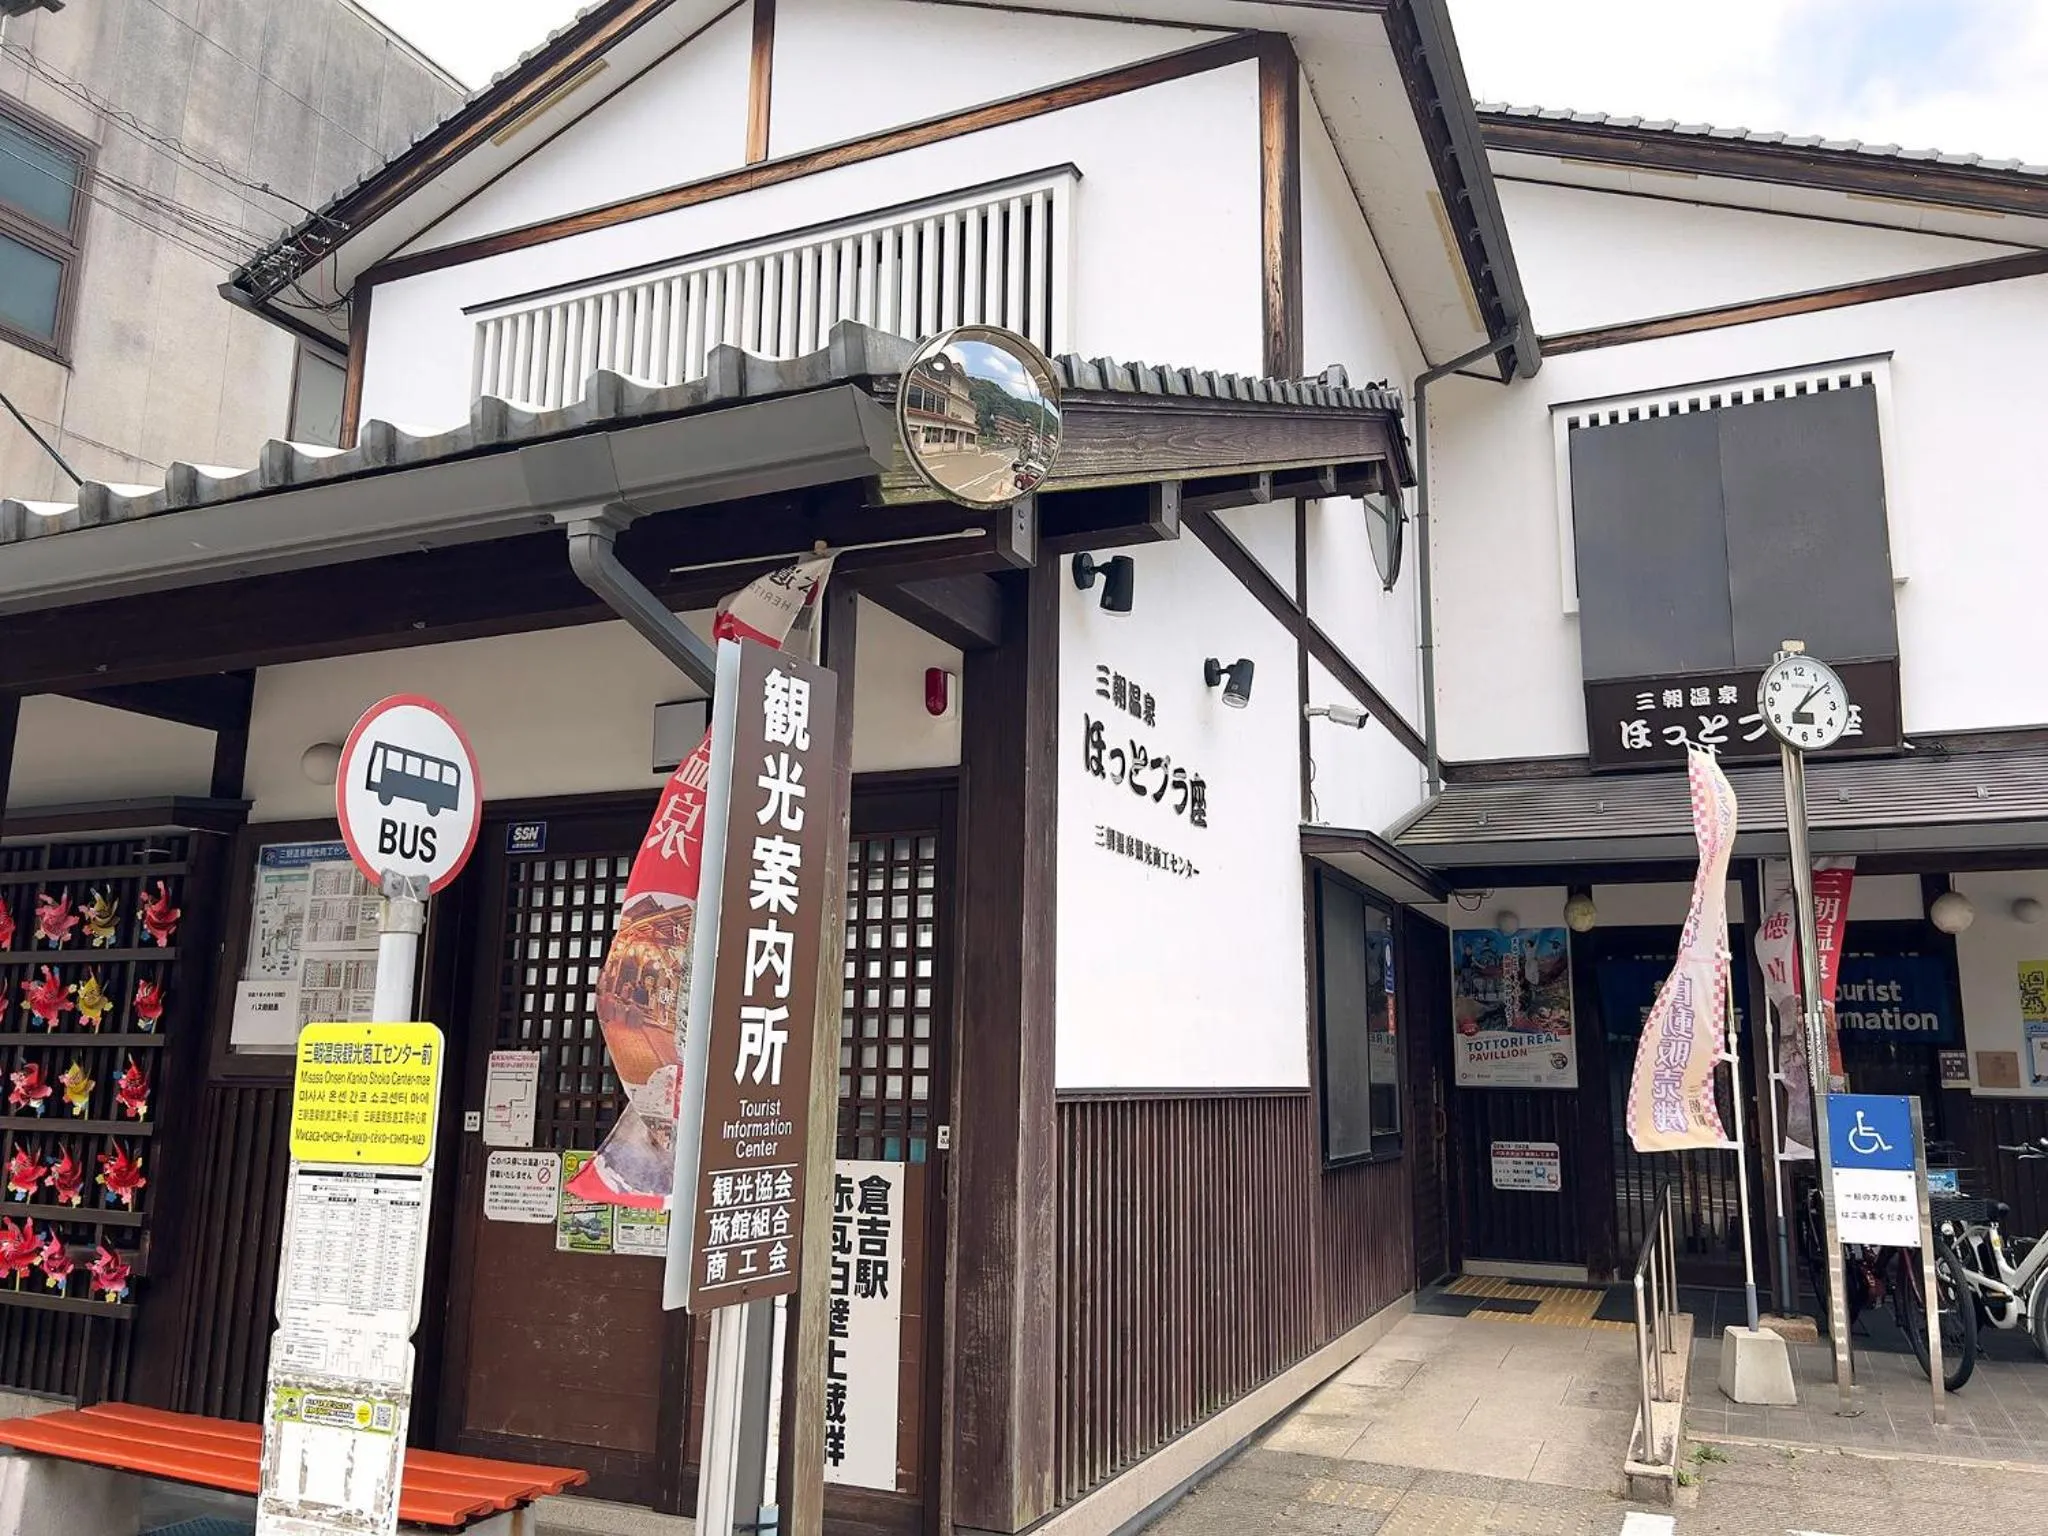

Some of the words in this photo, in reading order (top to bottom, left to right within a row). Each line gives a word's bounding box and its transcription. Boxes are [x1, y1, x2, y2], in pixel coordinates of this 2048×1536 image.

[1781, 671, 1789, 680] 11
[1794, 667, 1804, 677] 12
[1813, 673, 1818, 682] 1
[1096, 664, 1156, 728] 三朝温泉
[1770, 682, 1781, 692] 10
[1635, 685, 1738, 711] 三朝温泉
[1768, 697, 1775, 707] 9
[1829, 701, 1836, 711] 3
[1774, 714, 1781, 723] 8
[1826, 717, 1833, 727] 4
[1786, 726, 1793, 736] 7
[1801, 732, 1808, 741] 6
[1816, 728, 1823, 738] 5
[378, 819, 437, 863] BUS
[1095, 824, 1200, 879] 三朝温泉観光商工センター
[734, 668, 811, 1087] 観光案内所
[1836, 979, 1903, 1002] ourist
[1836, 1007, 1939, 1031] rmation
[1467, 1035, 1523, 1052] TOTTORI
[1527, 1033, 1561, 1046] REAL
[303, 1042, 432, 1066] 三朝温泉観光商工センター前
[1469, 1048, 1529, 1062] PAVILLION
[325, 1071, 346, 1084] Onsen
[739, 1099, 781, 1117] Tourist
[723, 1121, 793, 1140] Information
[736, 1141, 779, 1159] Center
[712, 1169, 794, 1207] 観光協会
[708, 1205, 791, 1246] 旅館組合
[854, 1174, 892, 1301] 倉吉駅
[706, 1240, 789, 1285] 商工会
